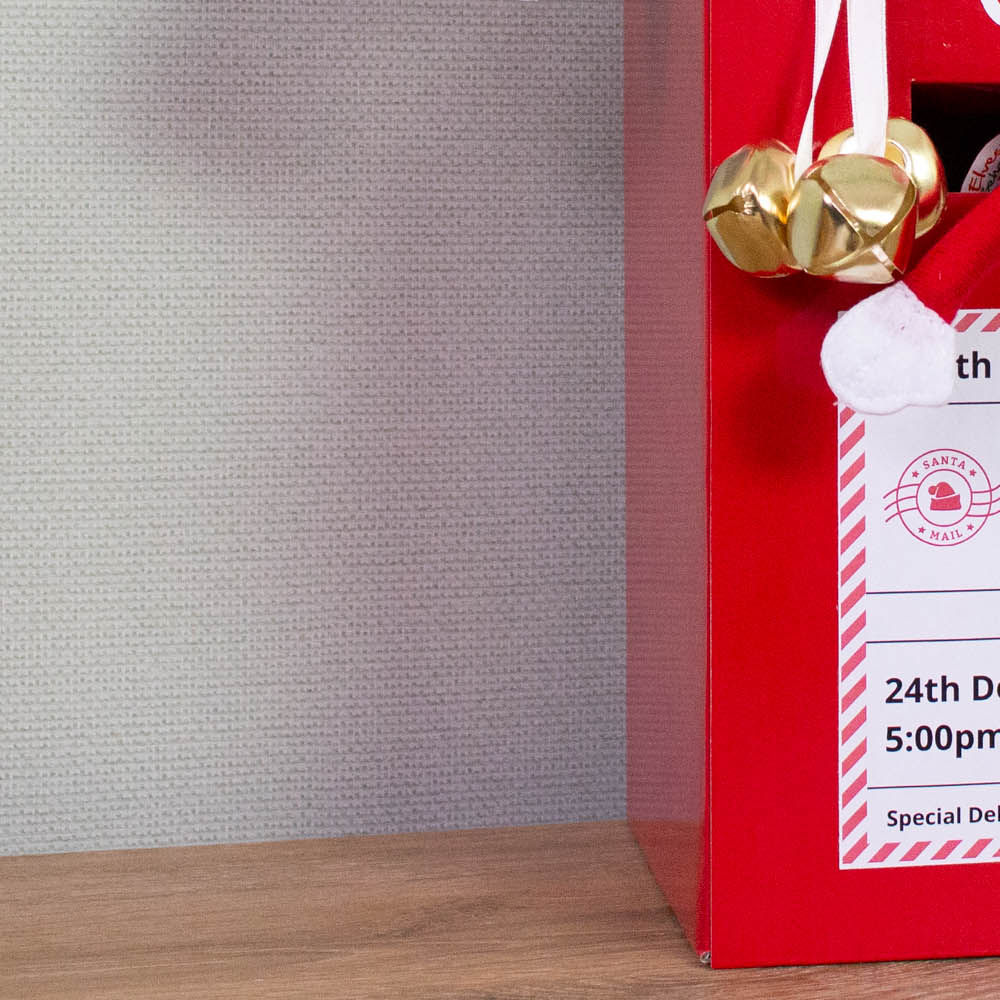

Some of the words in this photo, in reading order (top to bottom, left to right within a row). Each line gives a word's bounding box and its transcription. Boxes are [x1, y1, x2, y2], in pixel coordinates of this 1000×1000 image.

[922, 454, 967, 470] SANTA
[929, 528, 964, 542] MAIL
[885, 675, 960, 704] 24th
[887, 806, 961, 832] Special
